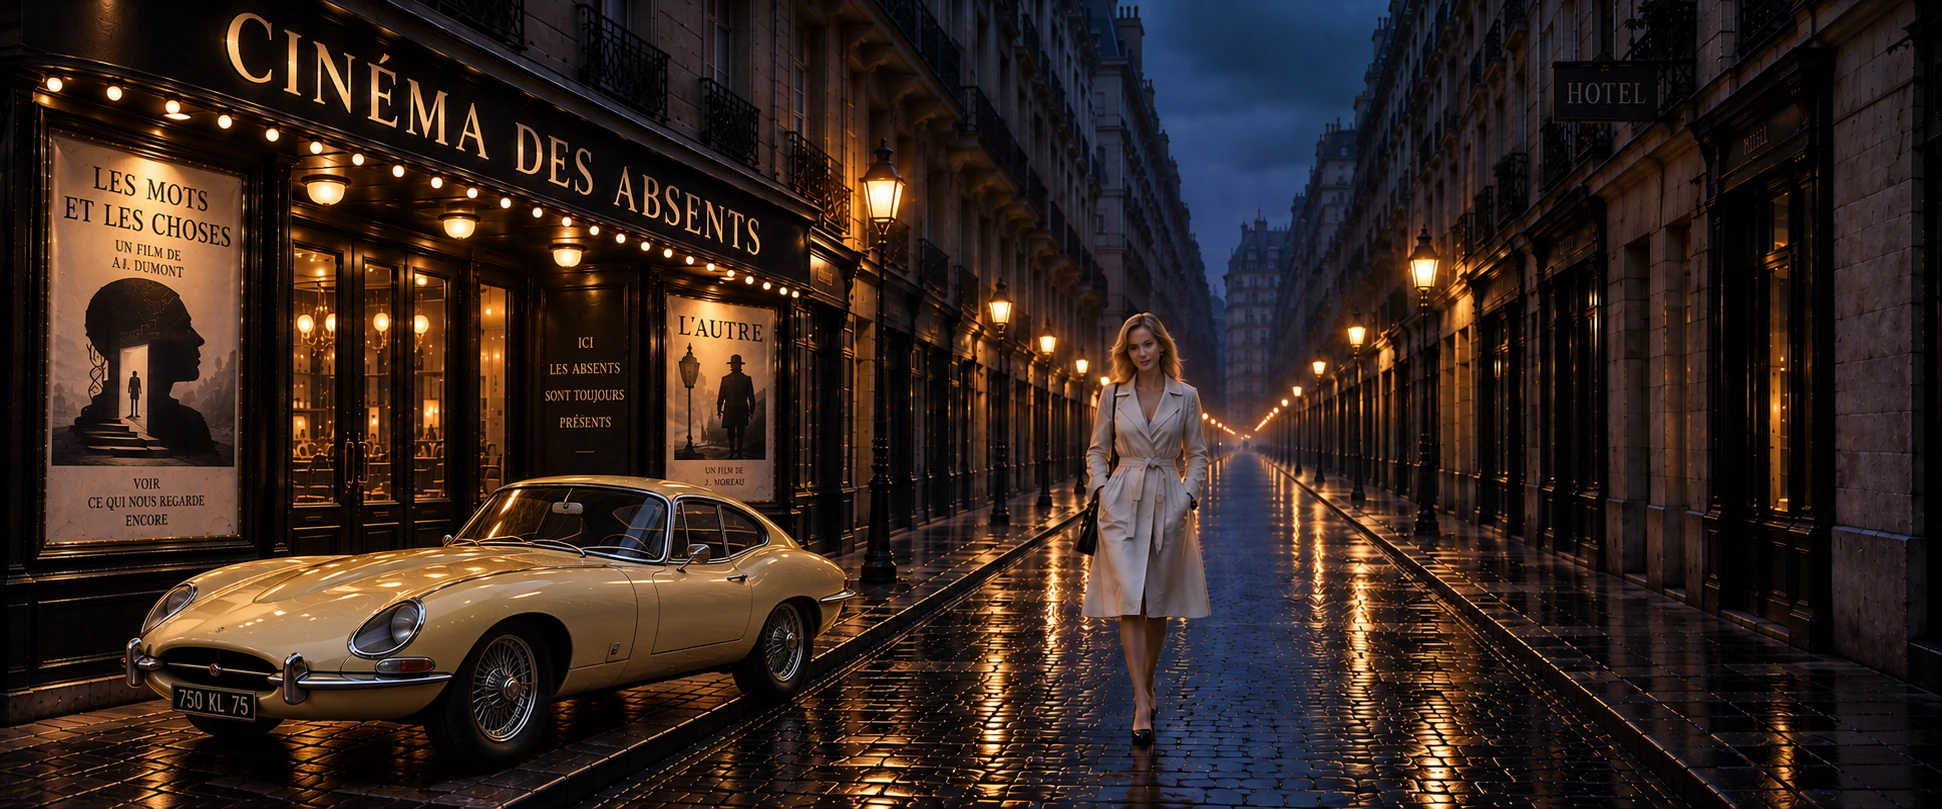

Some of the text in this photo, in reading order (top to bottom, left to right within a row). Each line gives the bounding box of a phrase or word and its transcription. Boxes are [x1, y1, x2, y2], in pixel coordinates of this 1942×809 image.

[1567, 82, 1647, 105] HOTEL
[226, 12, 761, 256] CINÉMA DES ABSENTS
[93, 166, 208, 212] LES MOTS
[64, 196, 232, 248] ET LES CHOSES
[115, 240, 181, 262] UN FILM DE
[134, 260, 184, 278] DUMONT
[678, 315, 763, 342] L'AUTRE
[578, 336, 594, 349] ICI
[549, 361, 621, 375] LES ABSENTS
[544, 388, 625, 404] SONT TOUJOURS
[704, 466, 716, 475] UN
[133, 478, 160, 490] VOIR
[87, 494, 205, 512] CE QUI NOUS REGARDE
[125, 513, 168, 527] ENCORE
[178, 689, 249, 716] 750 KL 75
